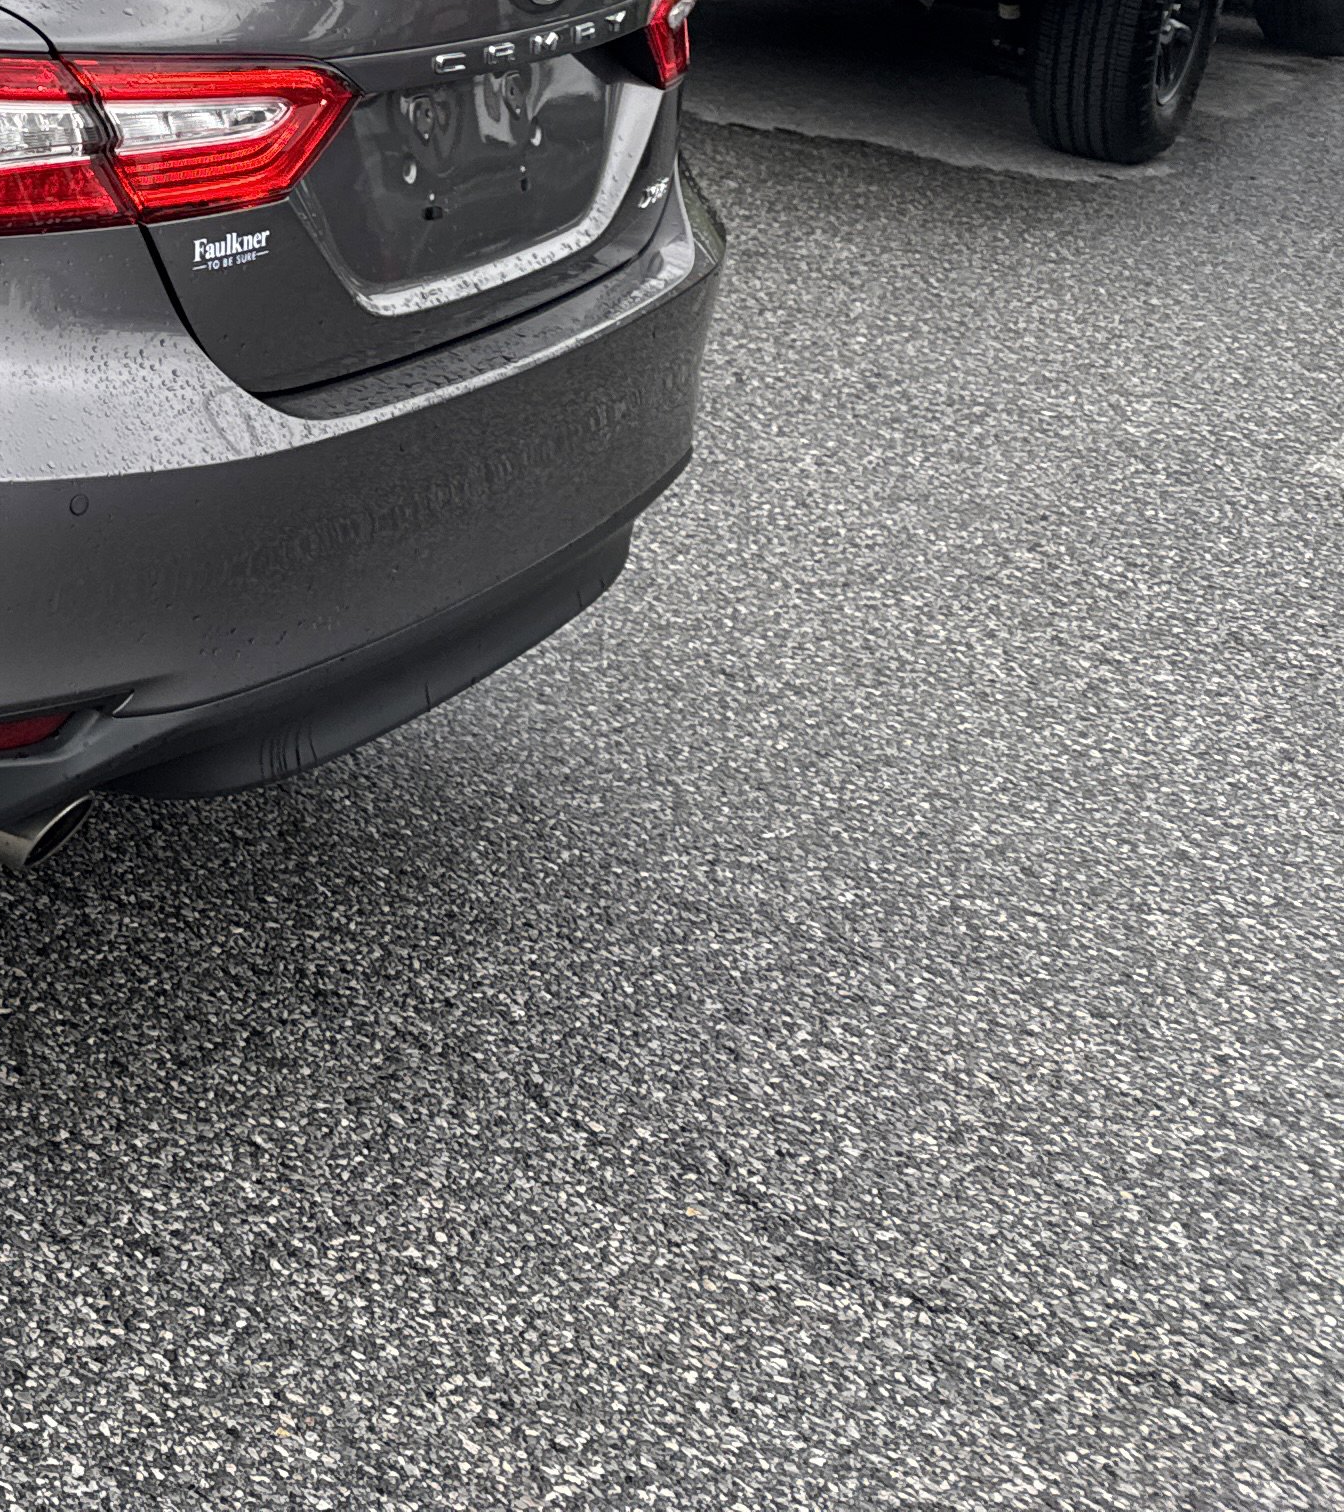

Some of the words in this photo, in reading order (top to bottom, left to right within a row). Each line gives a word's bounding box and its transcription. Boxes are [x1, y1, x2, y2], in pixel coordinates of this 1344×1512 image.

[193, 230, 270, 263] Faulkner
[207, 259, 221, 271] TO
[222, 256, 234, 268] BE
[236, 250, 257, 265] SURE
